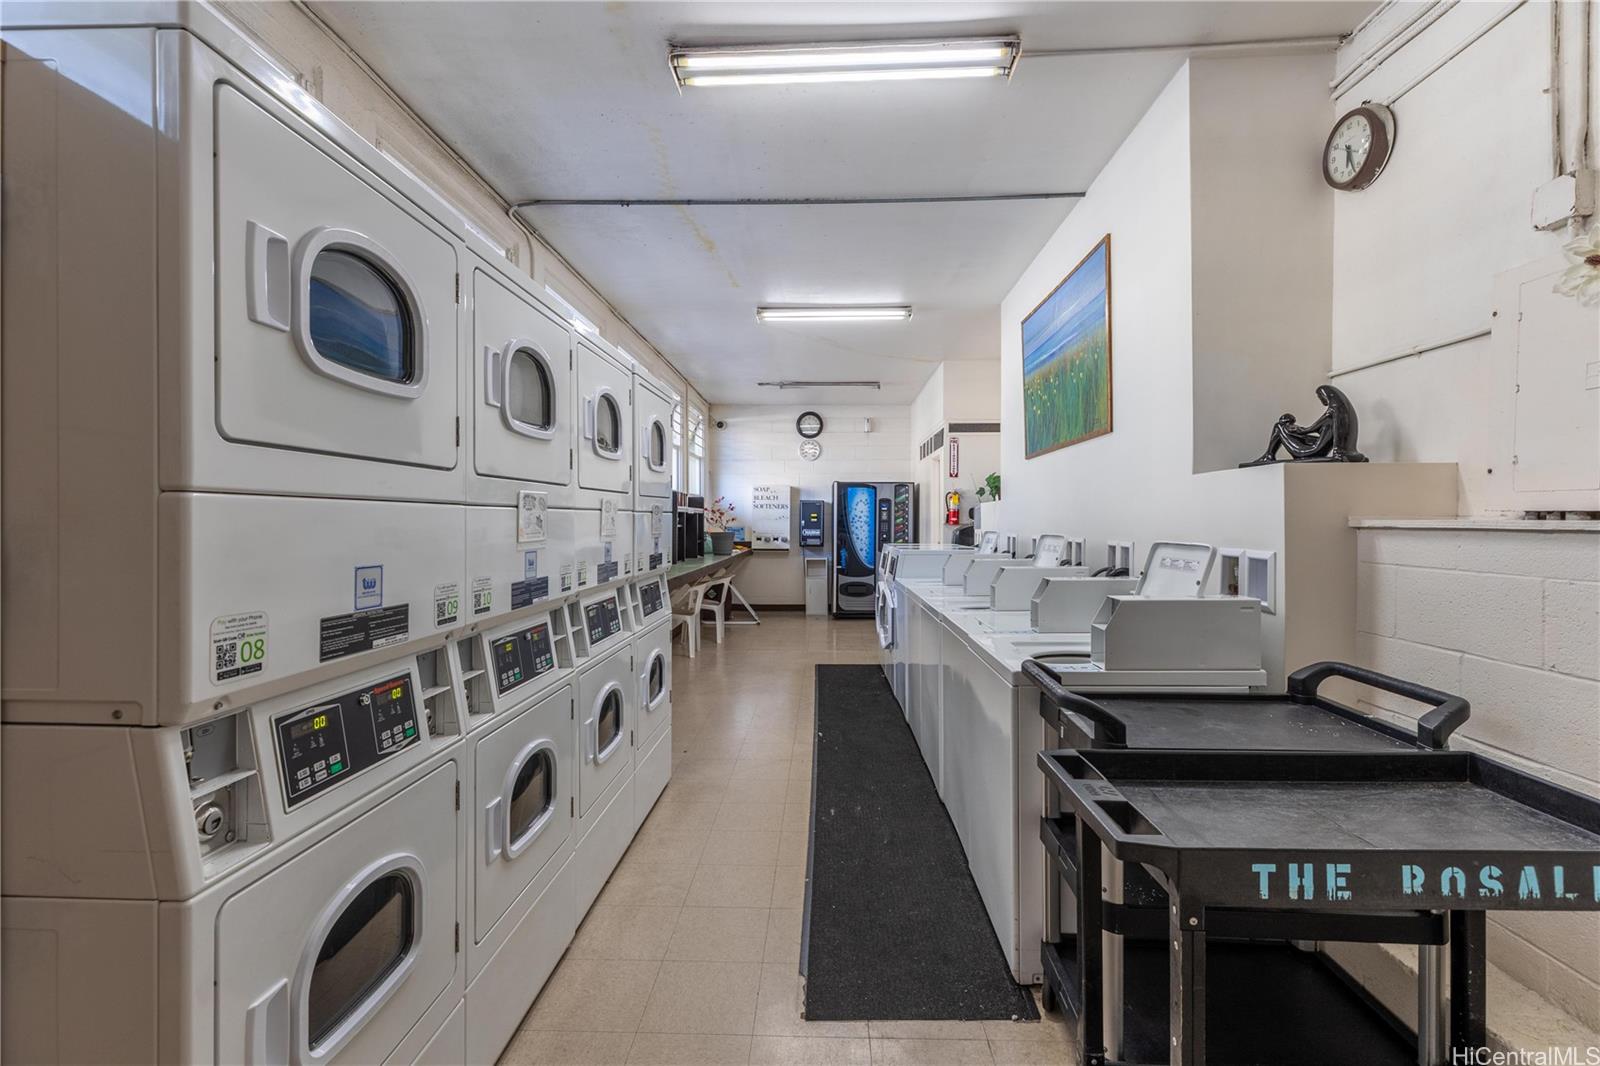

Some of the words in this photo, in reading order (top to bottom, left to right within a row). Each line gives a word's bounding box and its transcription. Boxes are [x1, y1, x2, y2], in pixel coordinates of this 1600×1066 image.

[447, 600, 458, 616] 09
[240, 639, 264, 662] 08
[313, 715, 326, 730] 00
[1252, 864, 1352, 900] THE
